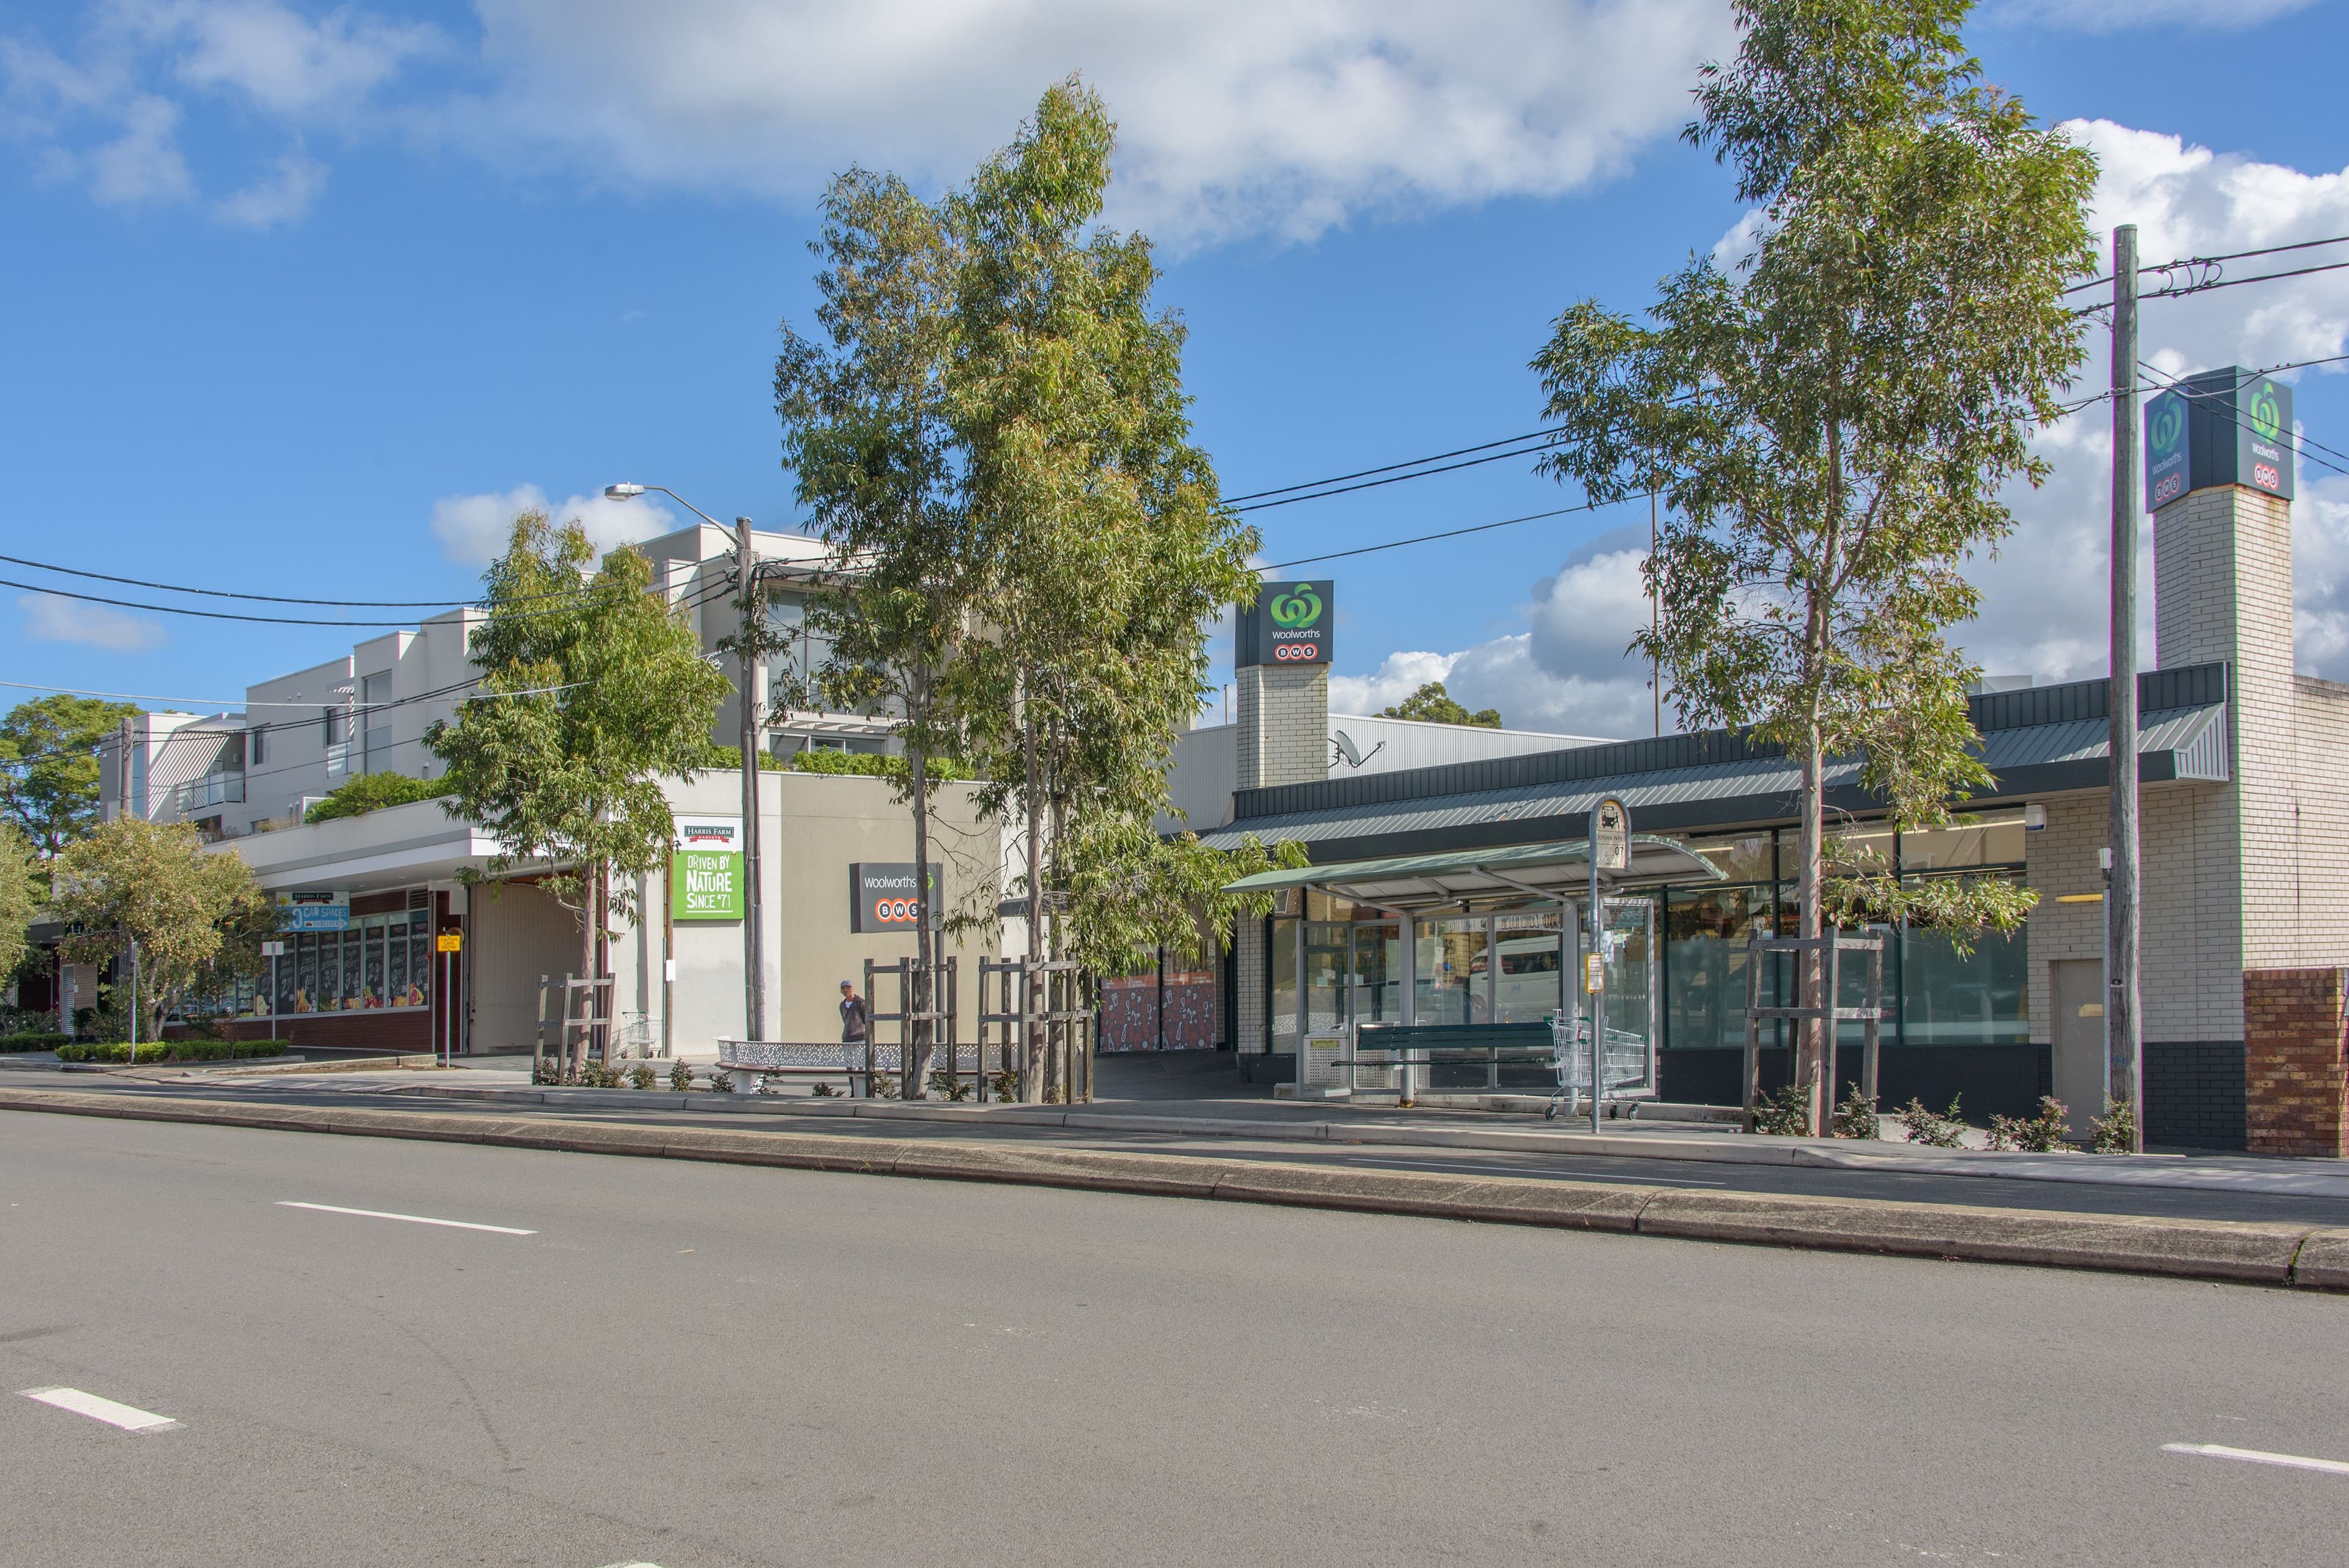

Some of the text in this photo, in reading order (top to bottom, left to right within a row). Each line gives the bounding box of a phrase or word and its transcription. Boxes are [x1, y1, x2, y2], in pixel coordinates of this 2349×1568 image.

[2252, 442, 2279, 462] Woolworths
[2152, 451, 2181, 475] Woolworths
[1272, 629, 1320, 640] Woolworths
[1278, 645, 1313, 657] BWS
[1615, 846, 1624, 856] 07
[688, 854, 730, 870] DRIVEN BY
[686, 870, 732, 892] NATURE
[864, 875, 916, 888] Woolworths
[686, 893, 716, 909] SINCE
[303, 907, 347, 917] CAR SPACES
[881, 904, 918, 916] BWS
